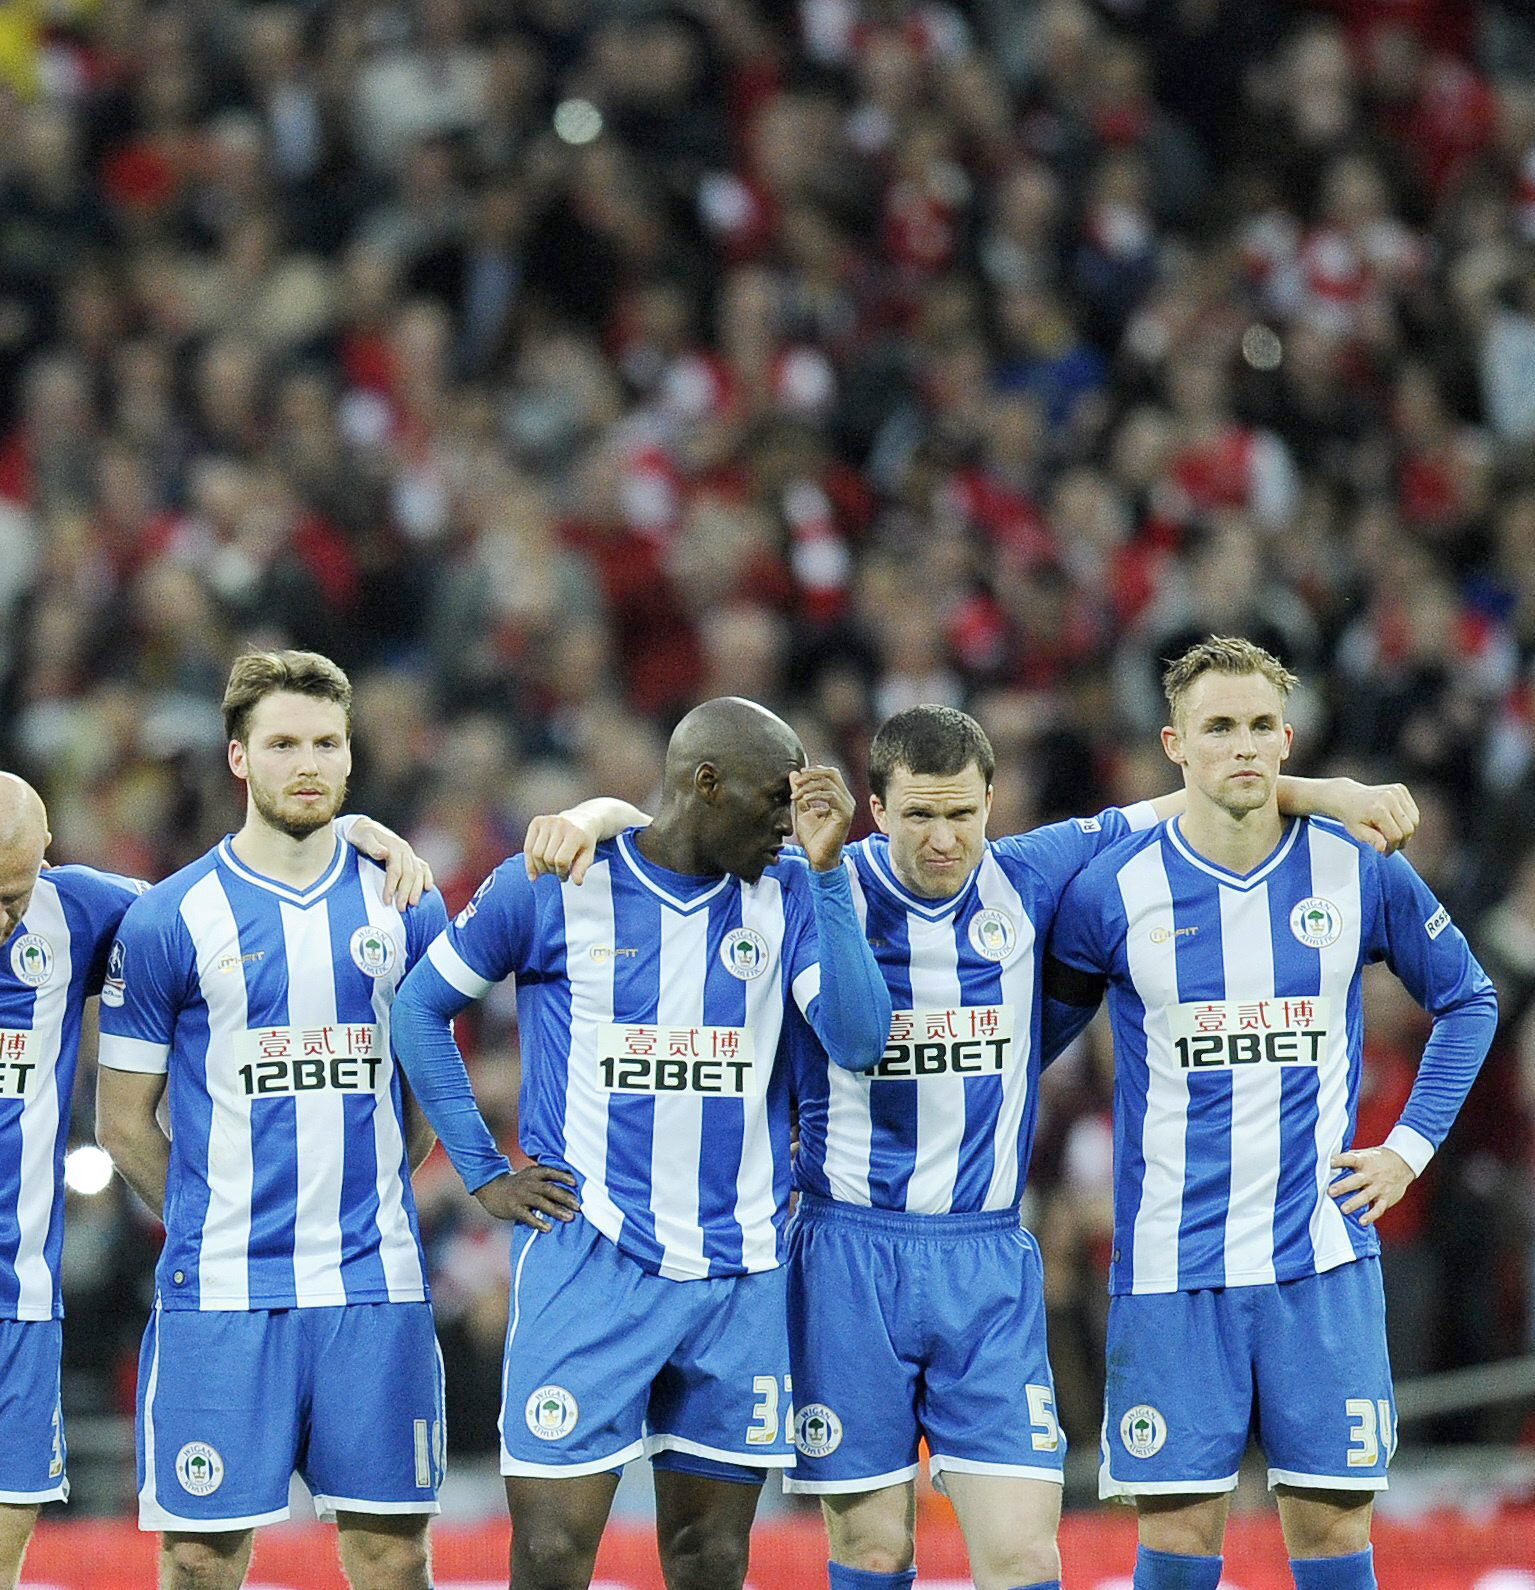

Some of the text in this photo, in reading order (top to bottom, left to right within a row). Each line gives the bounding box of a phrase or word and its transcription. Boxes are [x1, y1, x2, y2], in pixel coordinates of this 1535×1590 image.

[1194, 1000, 1314, 1032] 壹贰博
[258, 1026, 373, 1059] 壹贰博
[625, 1029, 740, 1058] 壹贰博
[865, 1037, 1011, 1076] 2BET
[1174, 1031, 1326, 1068] 12BET
[238, 1057, 382, 1095] 12BET
[600, 1057, 753, 1093] 12BET
[1025, 1384, 1059, 1452] 5
